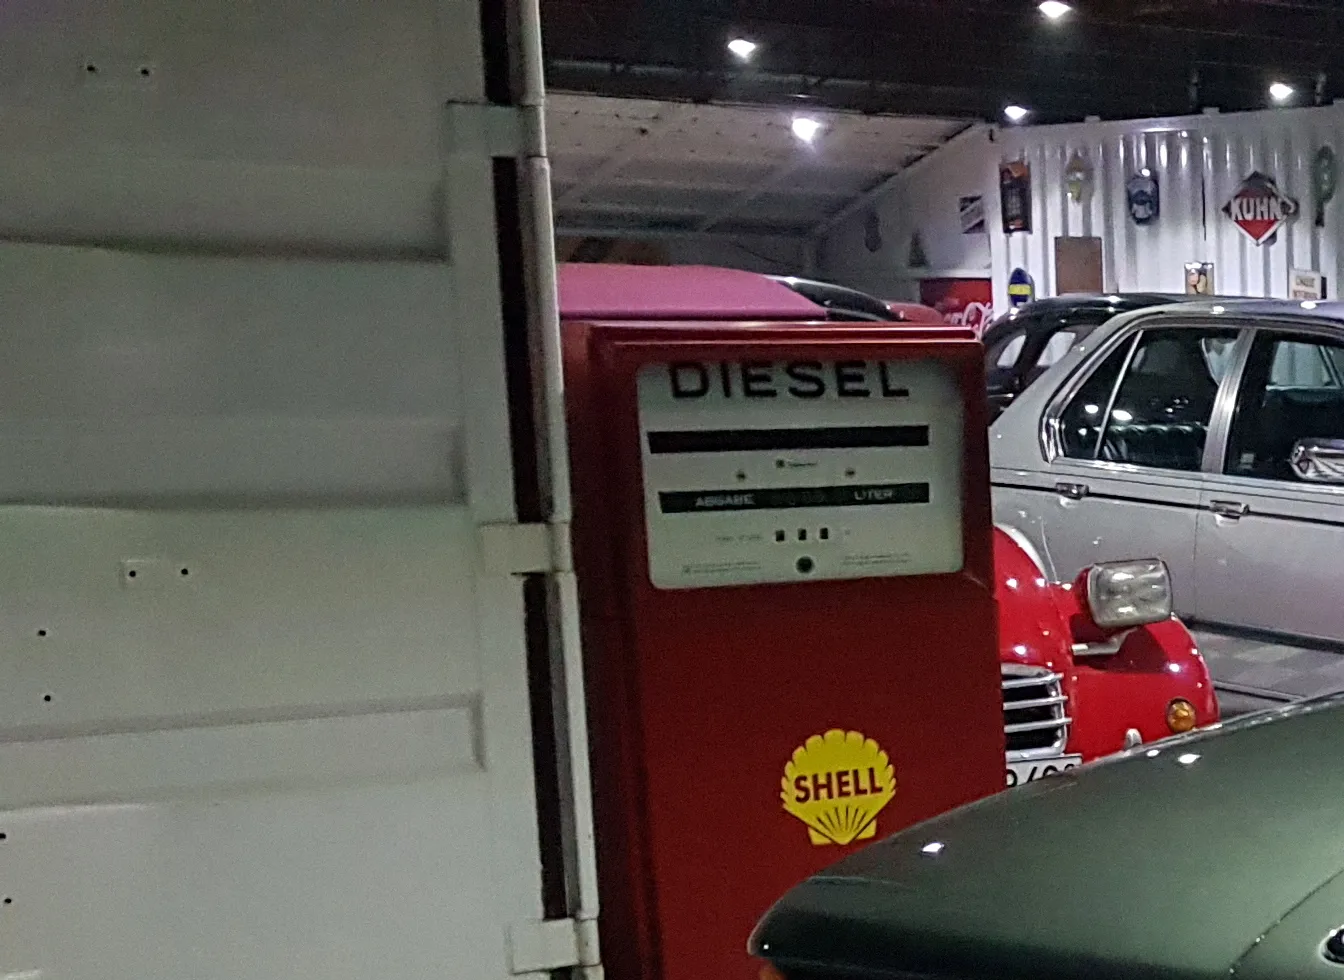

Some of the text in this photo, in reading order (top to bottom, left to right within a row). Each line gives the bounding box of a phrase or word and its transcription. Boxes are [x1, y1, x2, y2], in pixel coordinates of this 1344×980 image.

[1230, 196, 1281, 221] KUHN
[670, 360, 910, 398] DIESEL
[794, 767, 884, 803] SHELL
